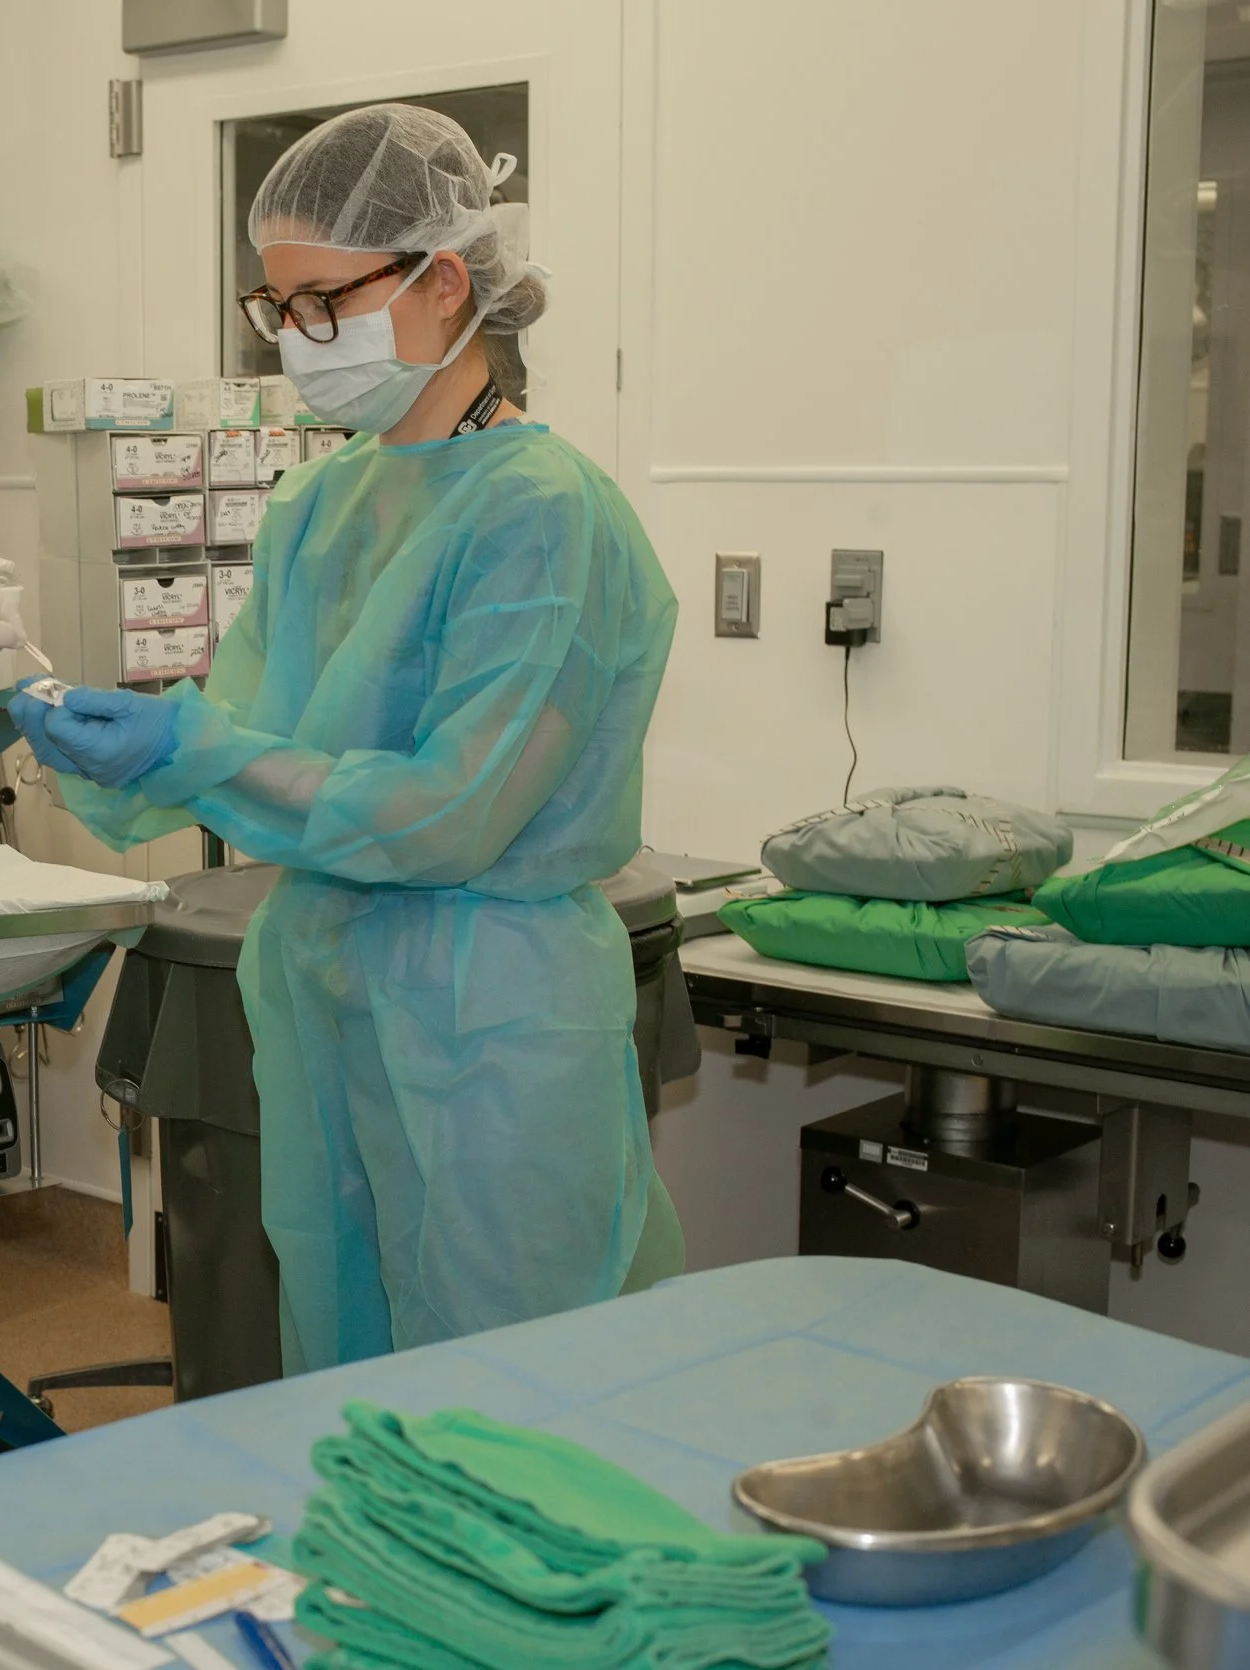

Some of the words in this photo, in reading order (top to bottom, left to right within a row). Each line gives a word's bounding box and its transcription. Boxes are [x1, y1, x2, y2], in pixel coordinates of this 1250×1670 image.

[320, 439, 331, 448] 4-0
[125, 445, 138, 453] 4-0
[131, 505, 143, 513] 4-0
[219, 569, 232, 579] 3-0
[134, 586, 145, 595] 3-0
[135, 638, 147, 646] 4-0
